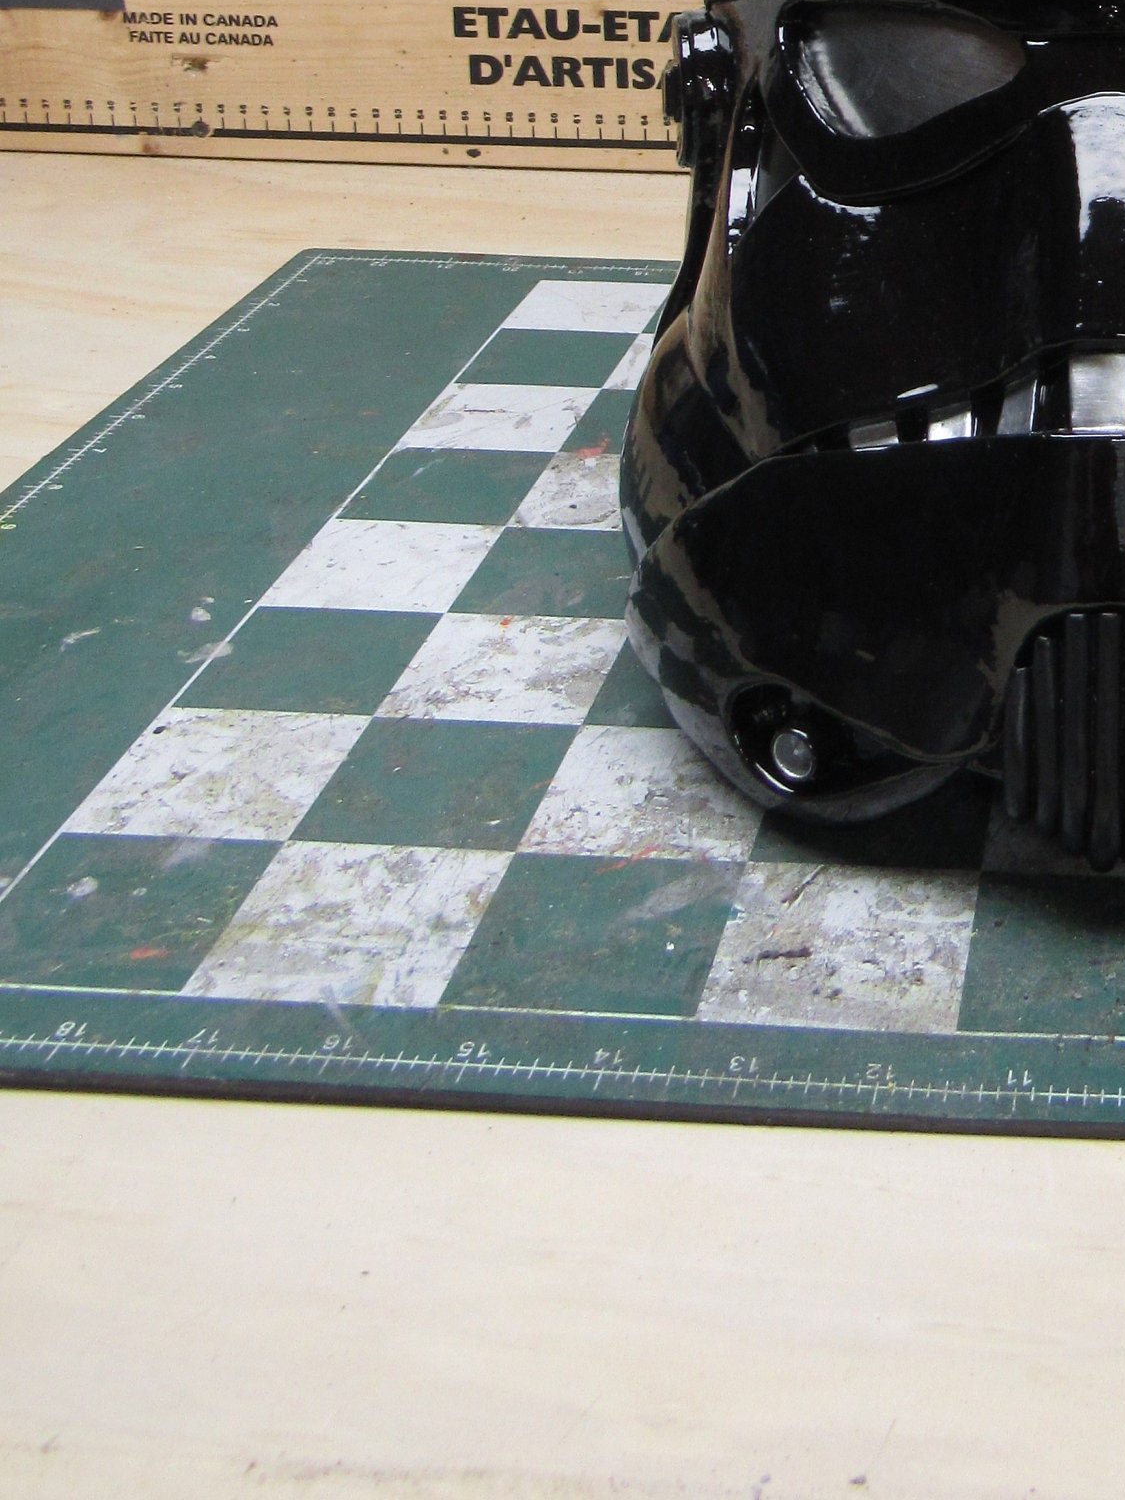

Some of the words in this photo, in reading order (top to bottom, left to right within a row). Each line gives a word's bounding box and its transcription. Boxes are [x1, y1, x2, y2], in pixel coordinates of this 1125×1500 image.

[122, 12, 173, 25] MADE
[180, 13, 197, 25] IN
[203, 14, 278, 27] CANADA
[129, 31, 174, 43] FAITE
[178, 32, 200, 44] AU
[205, 33, 274, 46] CANADA
[730, 1055, 758, 1072] 13
[866, 1063, 896, 1080] 12
[1006, 1069, 1032, 1087] 11
